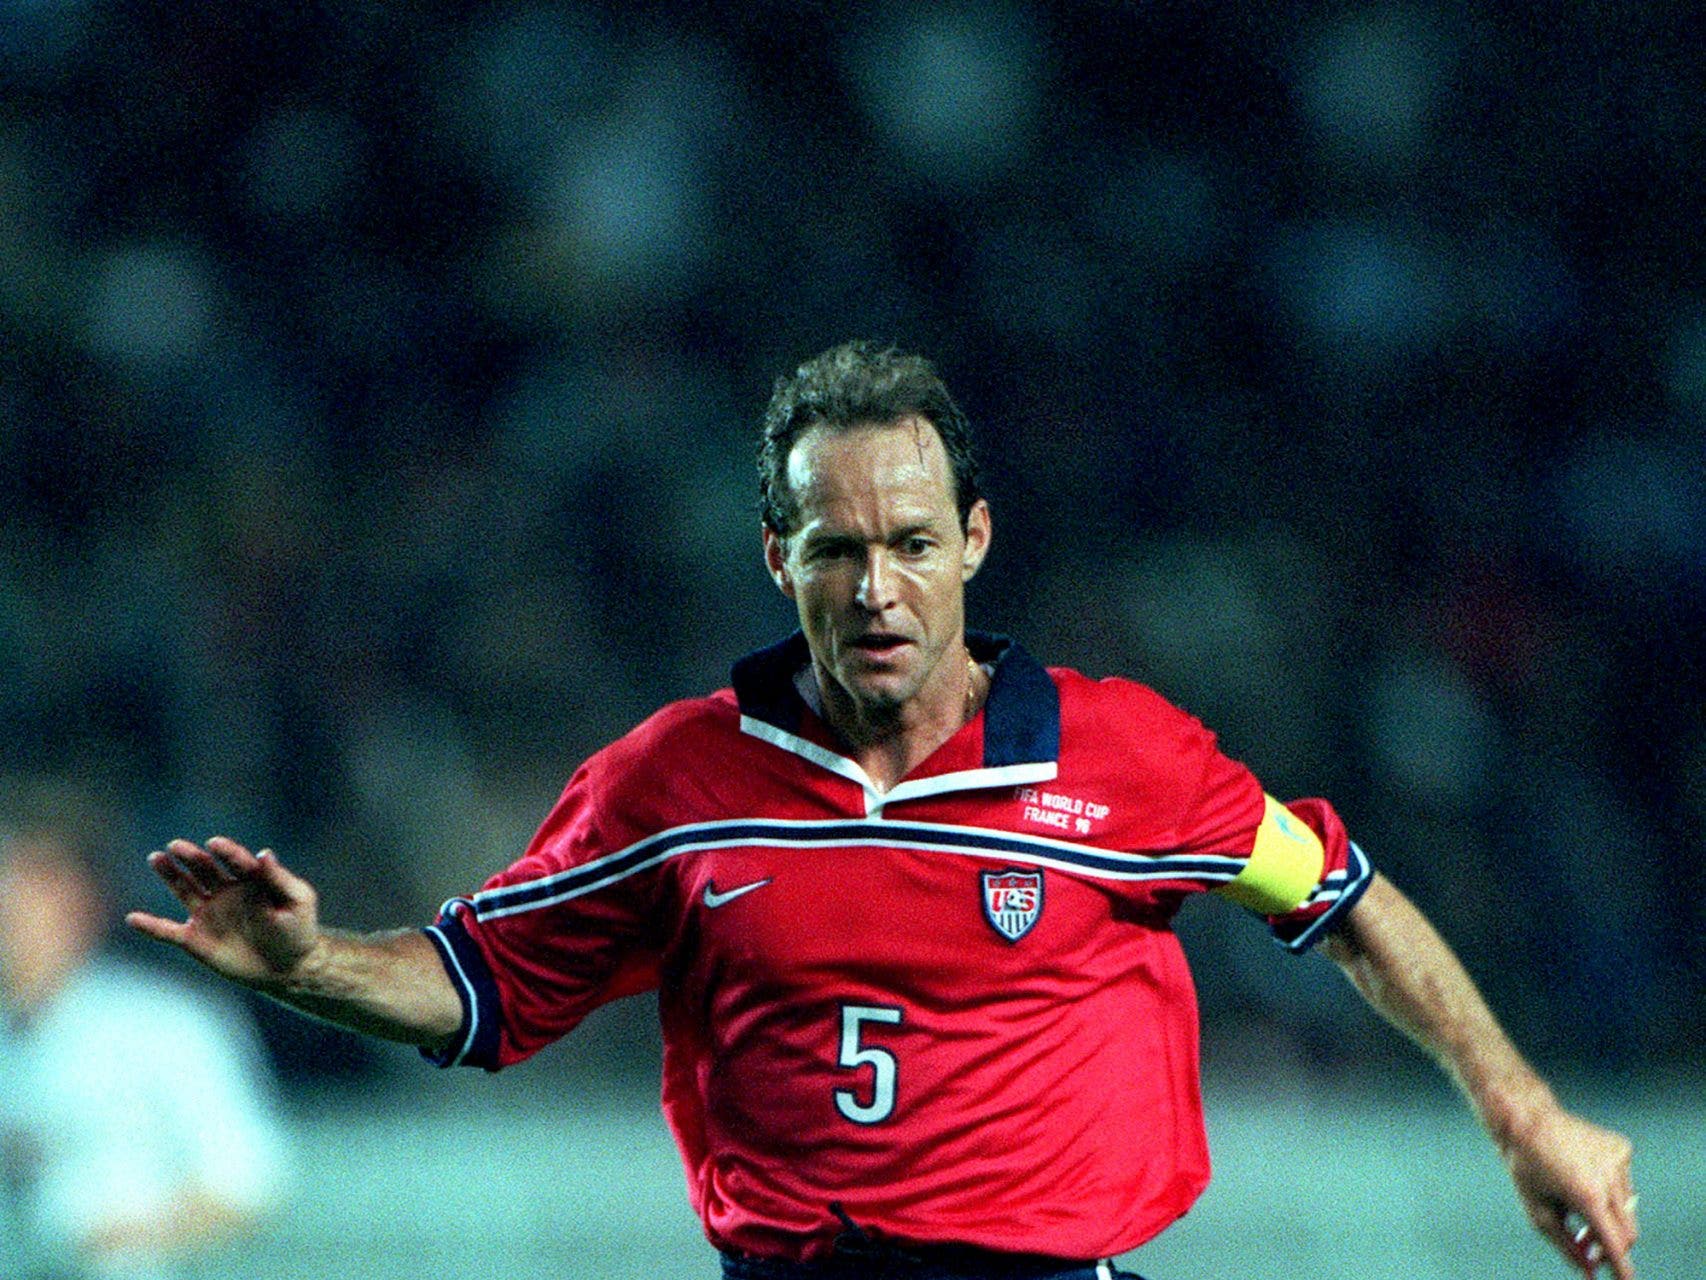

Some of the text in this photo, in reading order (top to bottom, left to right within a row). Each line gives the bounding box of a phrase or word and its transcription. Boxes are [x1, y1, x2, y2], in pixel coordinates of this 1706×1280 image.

[1013, 786, 1110, 819] FIFA WORLD CUP
[1024, 806, 1070, 829] FRANCE
[834, 1002, 903, 1125] 5
